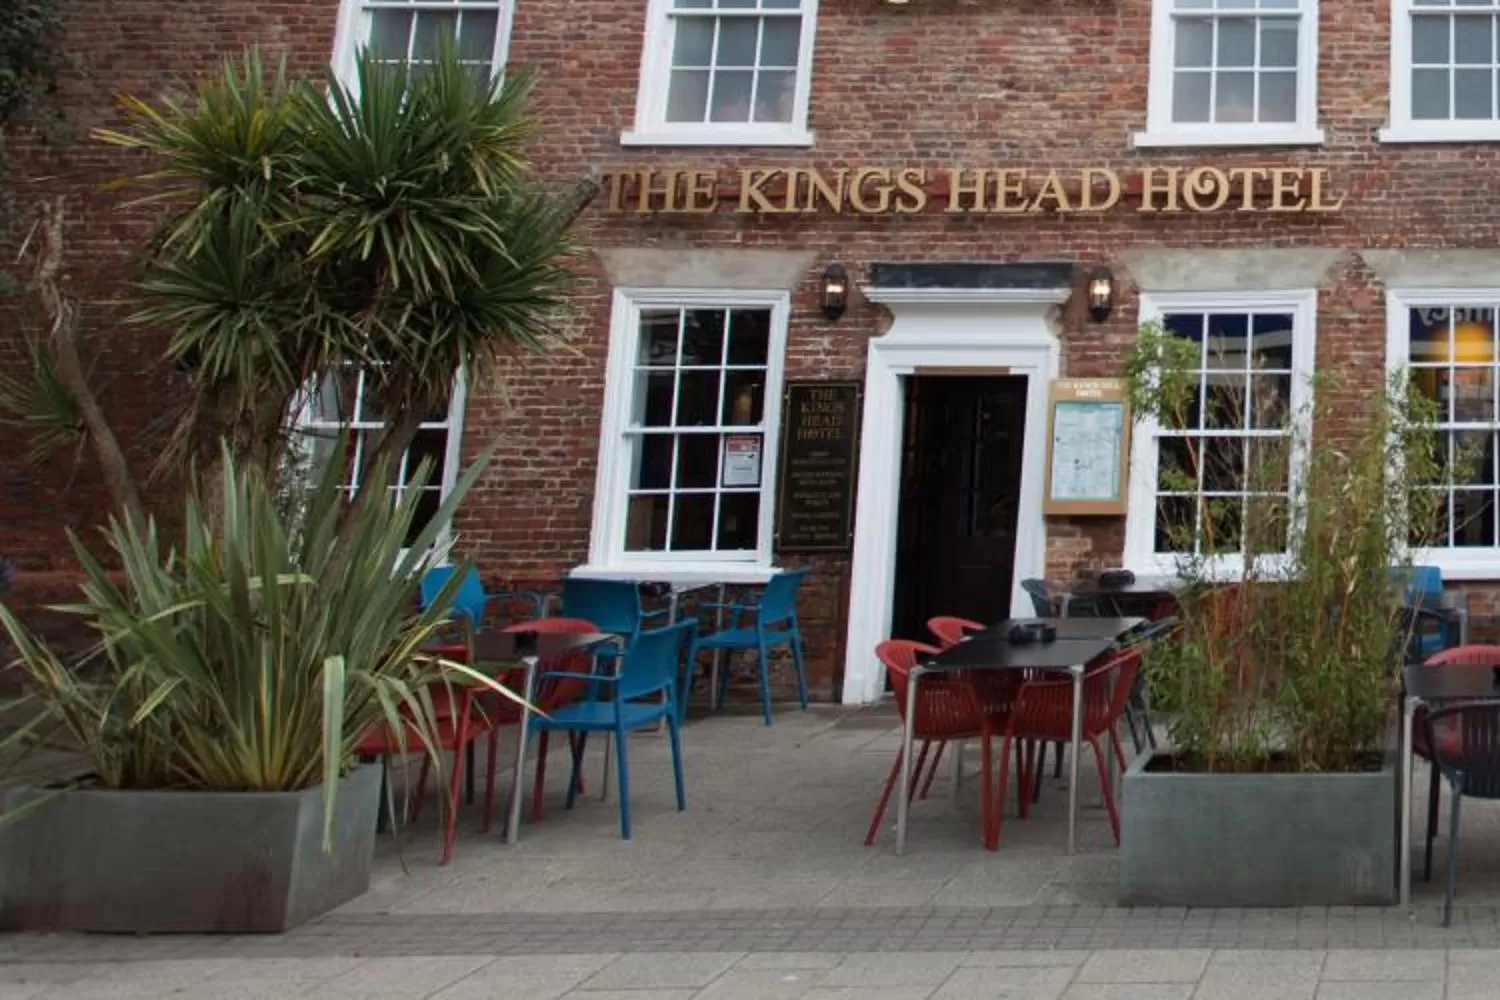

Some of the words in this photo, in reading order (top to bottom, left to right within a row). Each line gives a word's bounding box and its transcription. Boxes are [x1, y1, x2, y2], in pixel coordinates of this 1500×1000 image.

[602, 164, 718, 213] THE
[733, 166, 927, 213] KINGS
[944, 167, 1121, 213] HEAD
[1136, 165, 1348, 212] HOTEL
